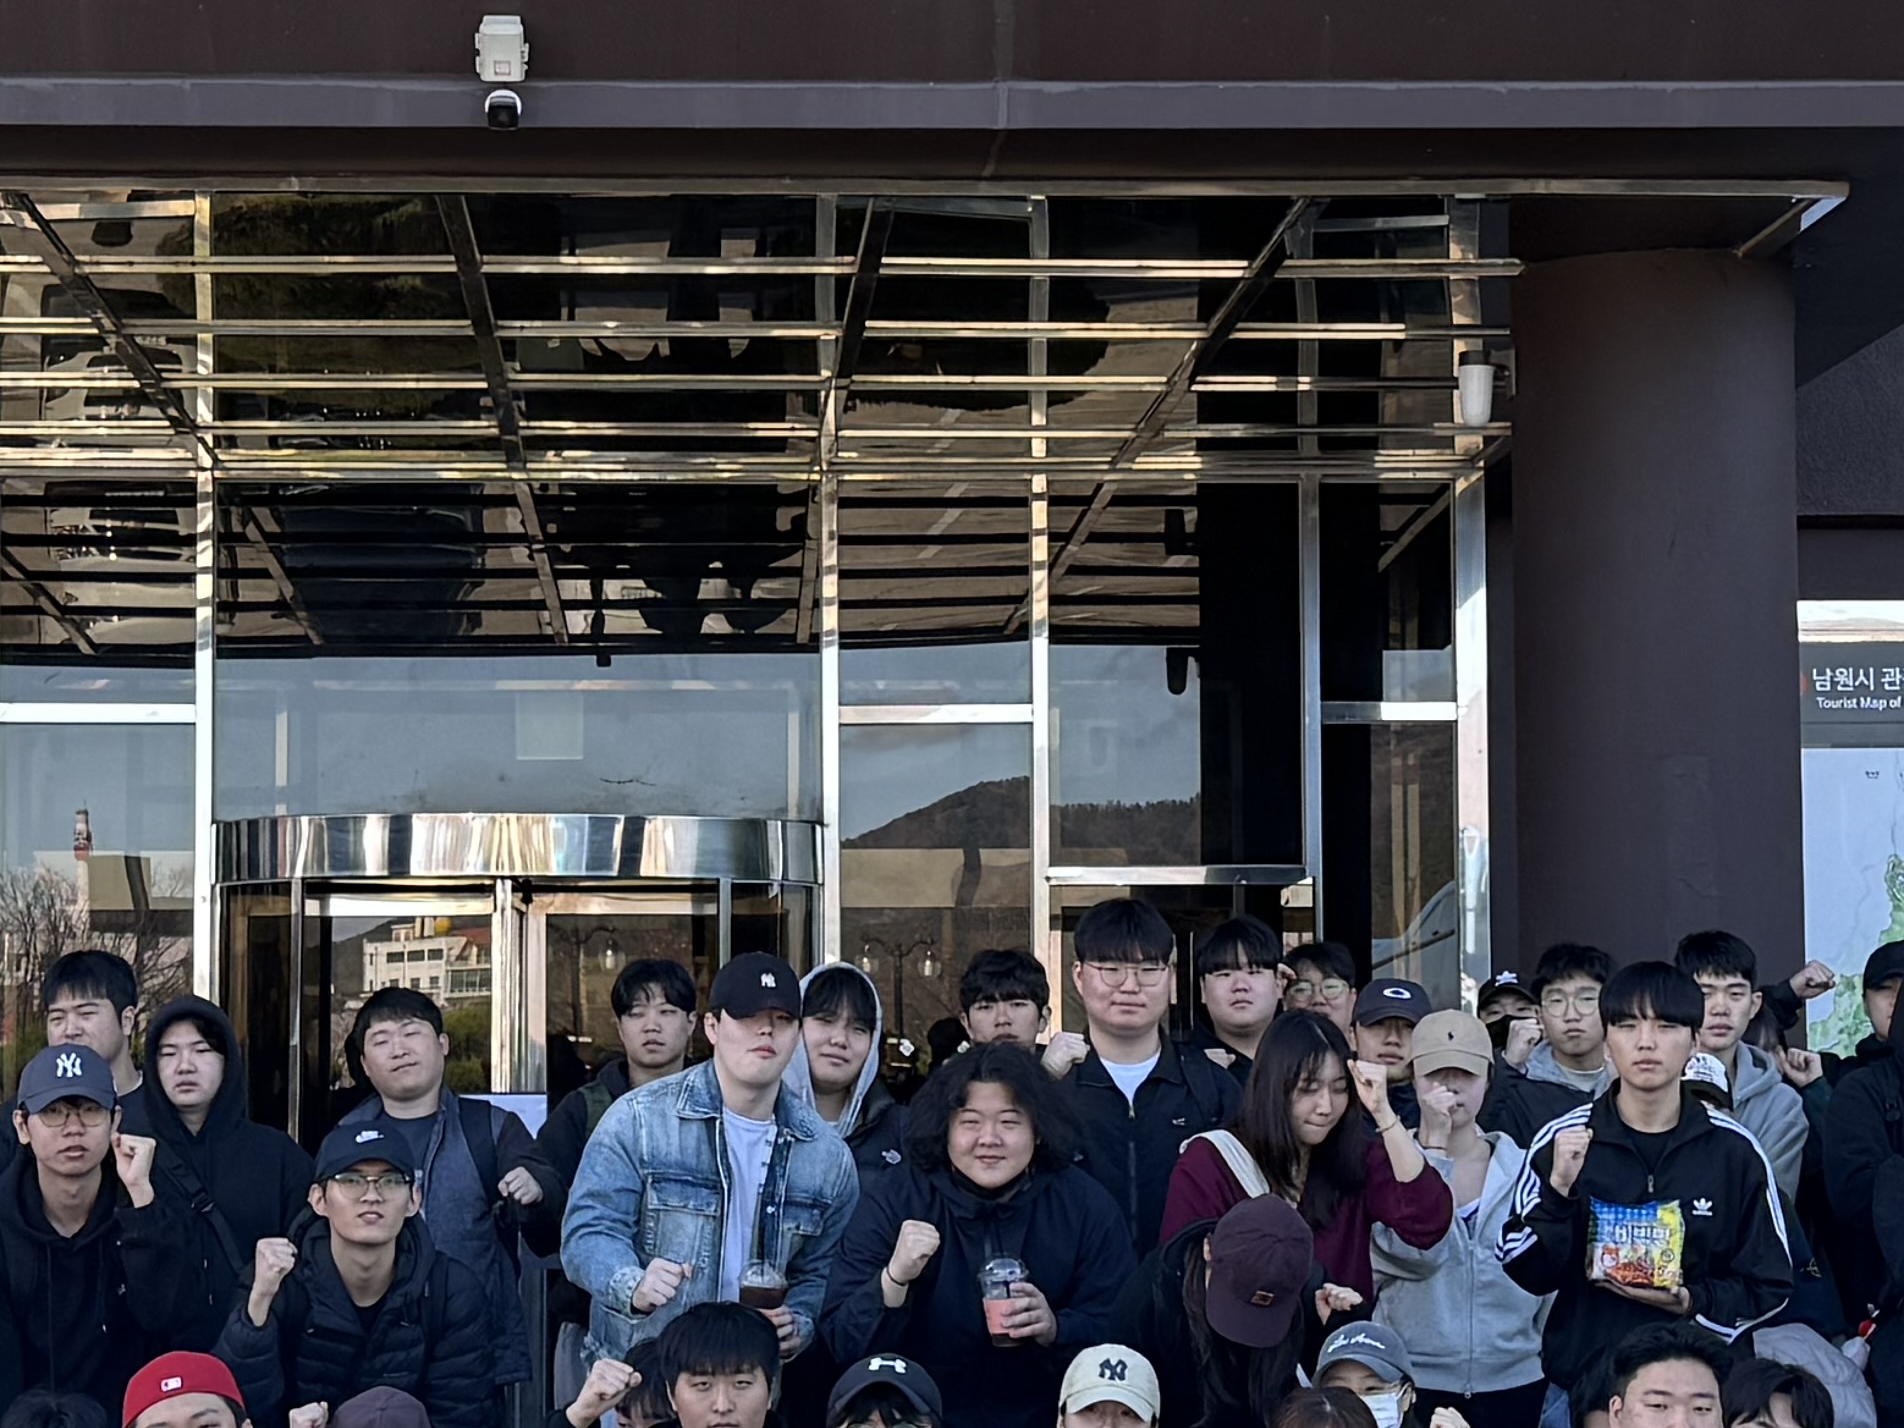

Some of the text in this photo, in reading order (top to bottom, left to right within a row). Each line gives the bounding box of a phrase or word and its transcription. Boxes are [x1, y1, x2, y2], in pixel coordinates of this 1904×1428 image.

[1811, 666, 1876, 692] 남원시
[1815, 696, 1858, 710] Tourist
[1859, 696, 1887, 712] Map
[1889, 695, 1902, 710] of
[56, 1052, 83, 1078] NY
[1098, 1357, 1129, 1382] NY
